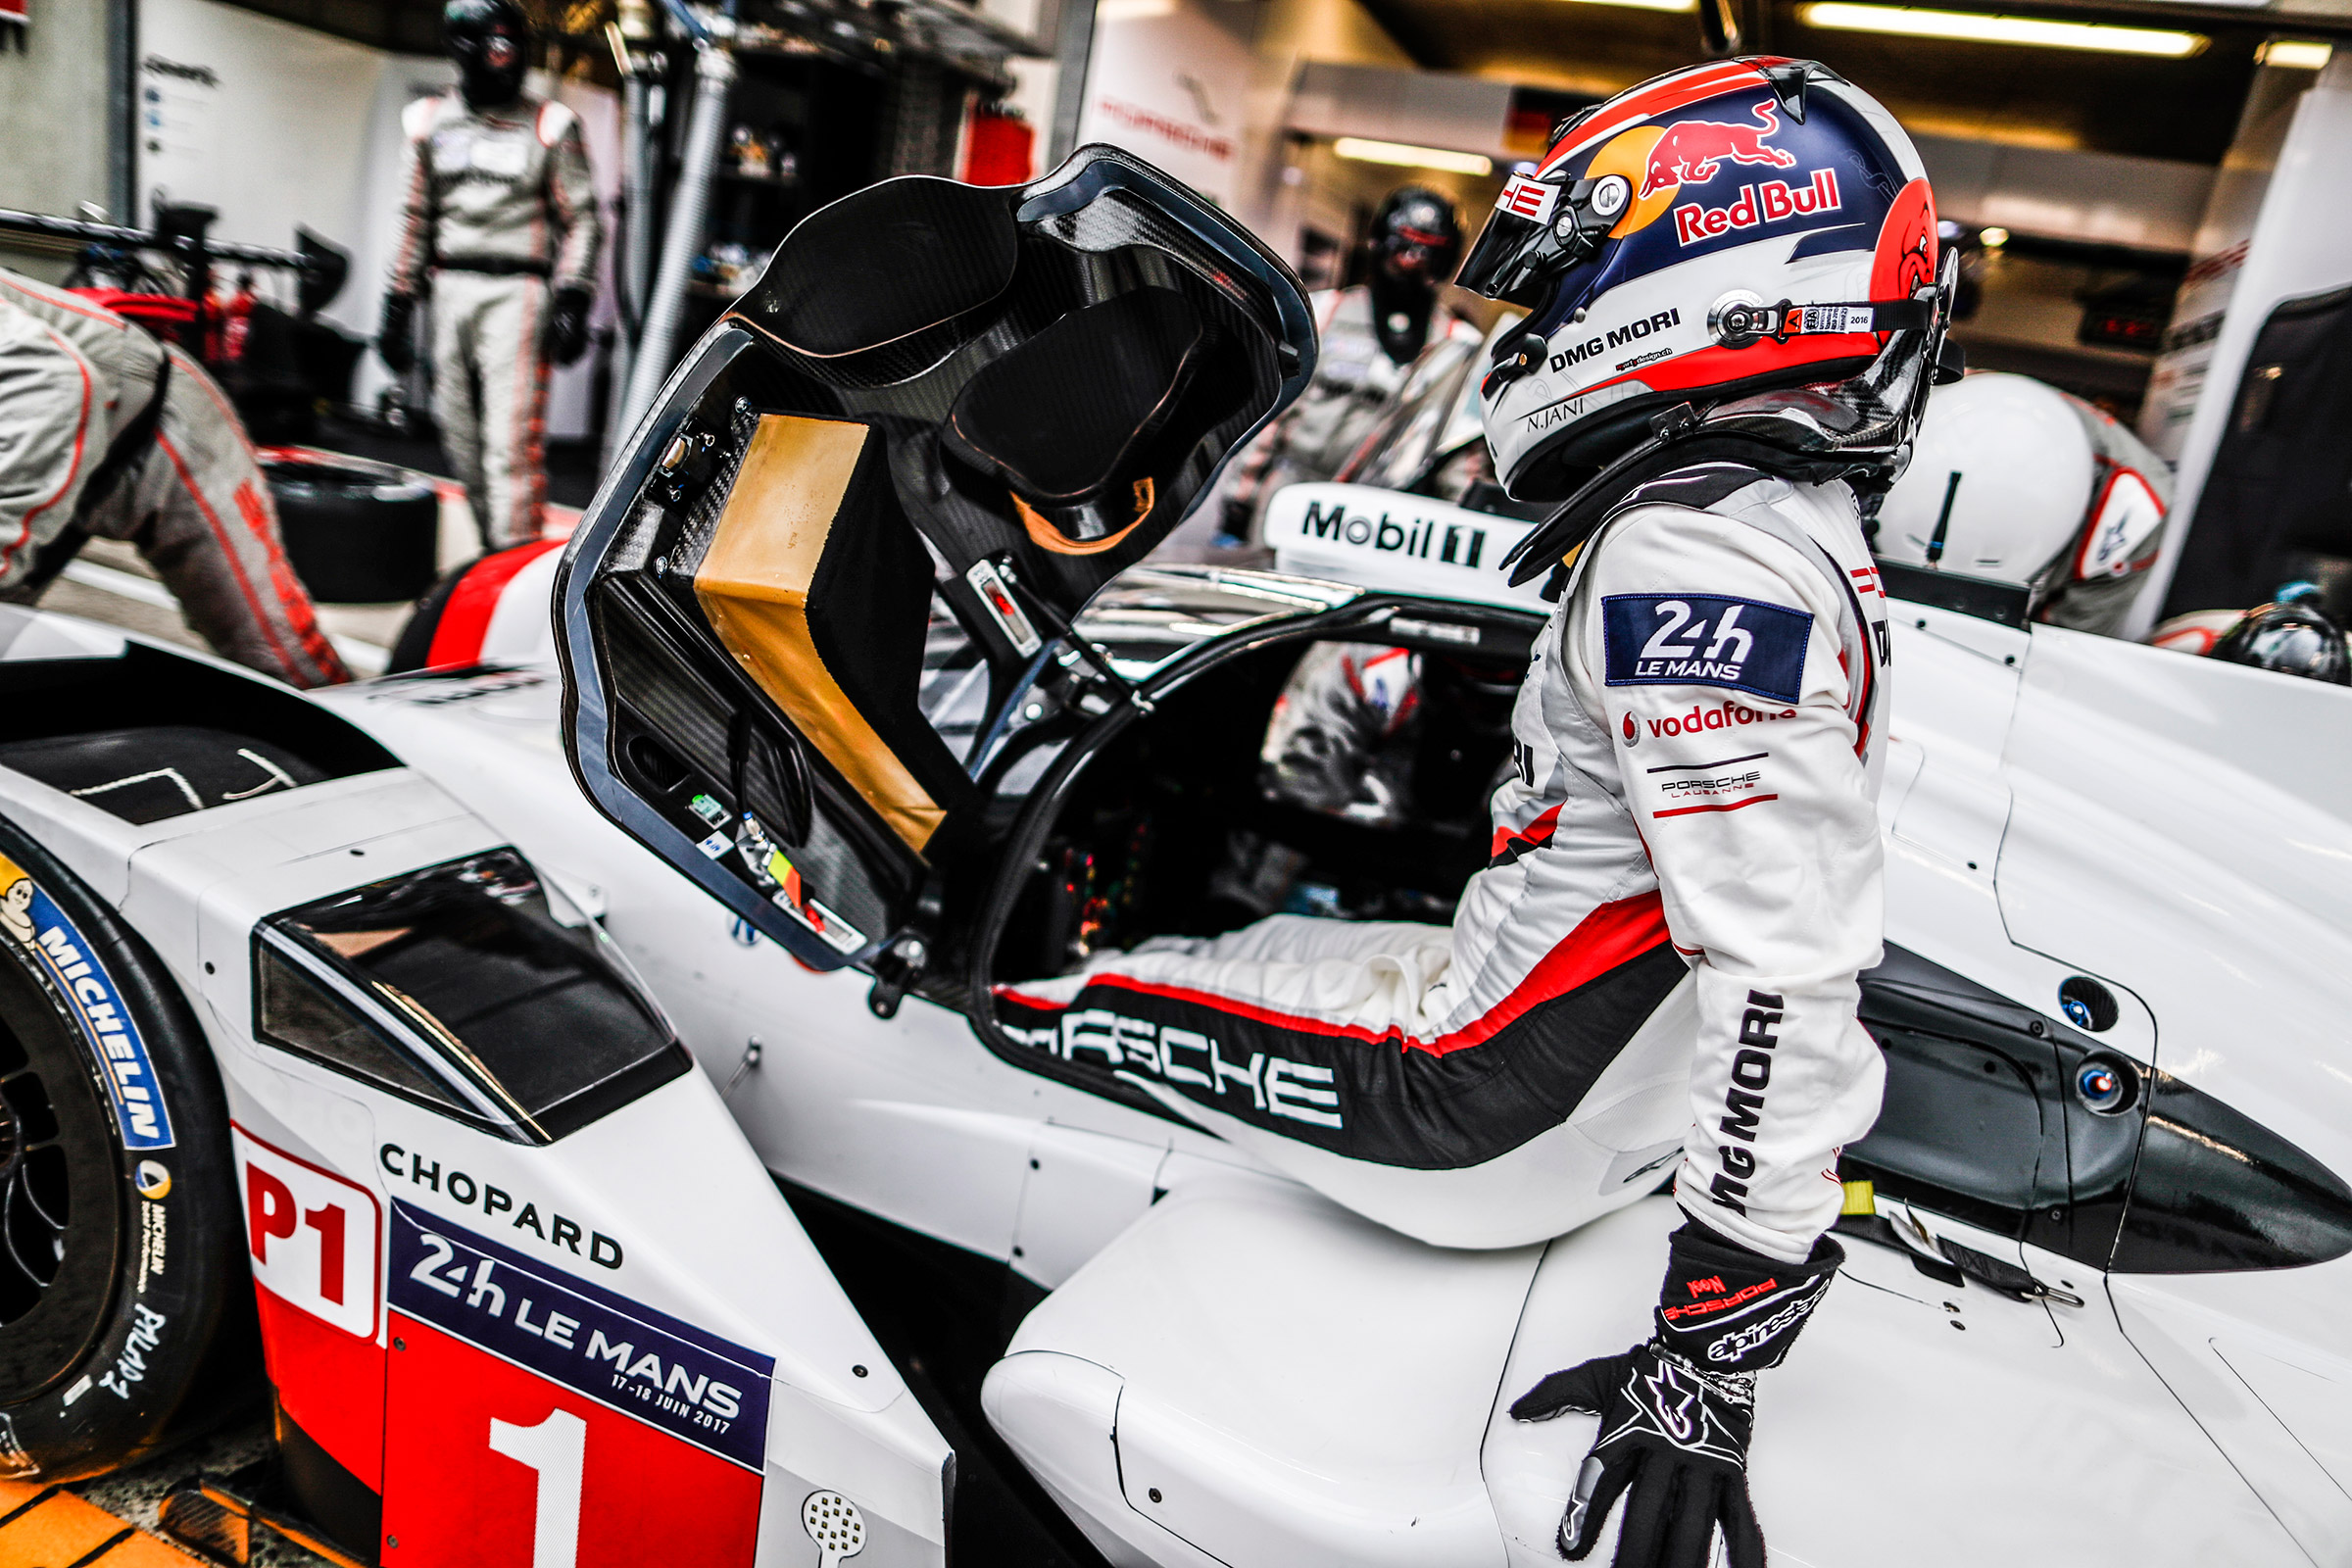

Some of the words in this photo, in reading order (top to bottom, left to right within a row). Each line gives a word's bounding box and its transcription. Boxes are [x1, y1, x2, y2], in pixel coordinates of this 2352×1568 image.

[1674, 184, 1758, 247] Red
[1758, 167, 1842, 223] Bull
[1549, 337, 1604, 372] DMG
[1605, 308, 1682, 349] MORI
[1850, 316, 1869, 324] 2016
[1527, 397, 1584, 433] N.JANI
[1301, 500, 1434, 560] Mobil
[1440, 523, 1487, 569] 1
[1640, 600, 1754, 663] 24h
[1635, 661, 1665, 676] LE
[1664, 661, 1742, 681] MANS
[1661, 770, 1761, 792] PORSCHE
[1671, 782, 1755, 799] LAUSANNE
[37, 925, 161, 1140] MICHELIN
[1719, 988, 1785, 1143] MORI
[149, 1202, 167, 1275] MICHELIN
[246, 1159, 346, 1307] P1
[379, 1143, 623, 1270] CHOPARD
[409, 1233, 509, 1317] 24h
[514, 1298, 582, 1350] LE
[584, 1328, 744, 1420] MANS
[1663, 1278, 1778, 1321] PORSCHE
[655, 1394, 691, 1419] JUIN
[693, 1410, 731, 1435] 2017
[489, 1407, 586, 1568] 1
